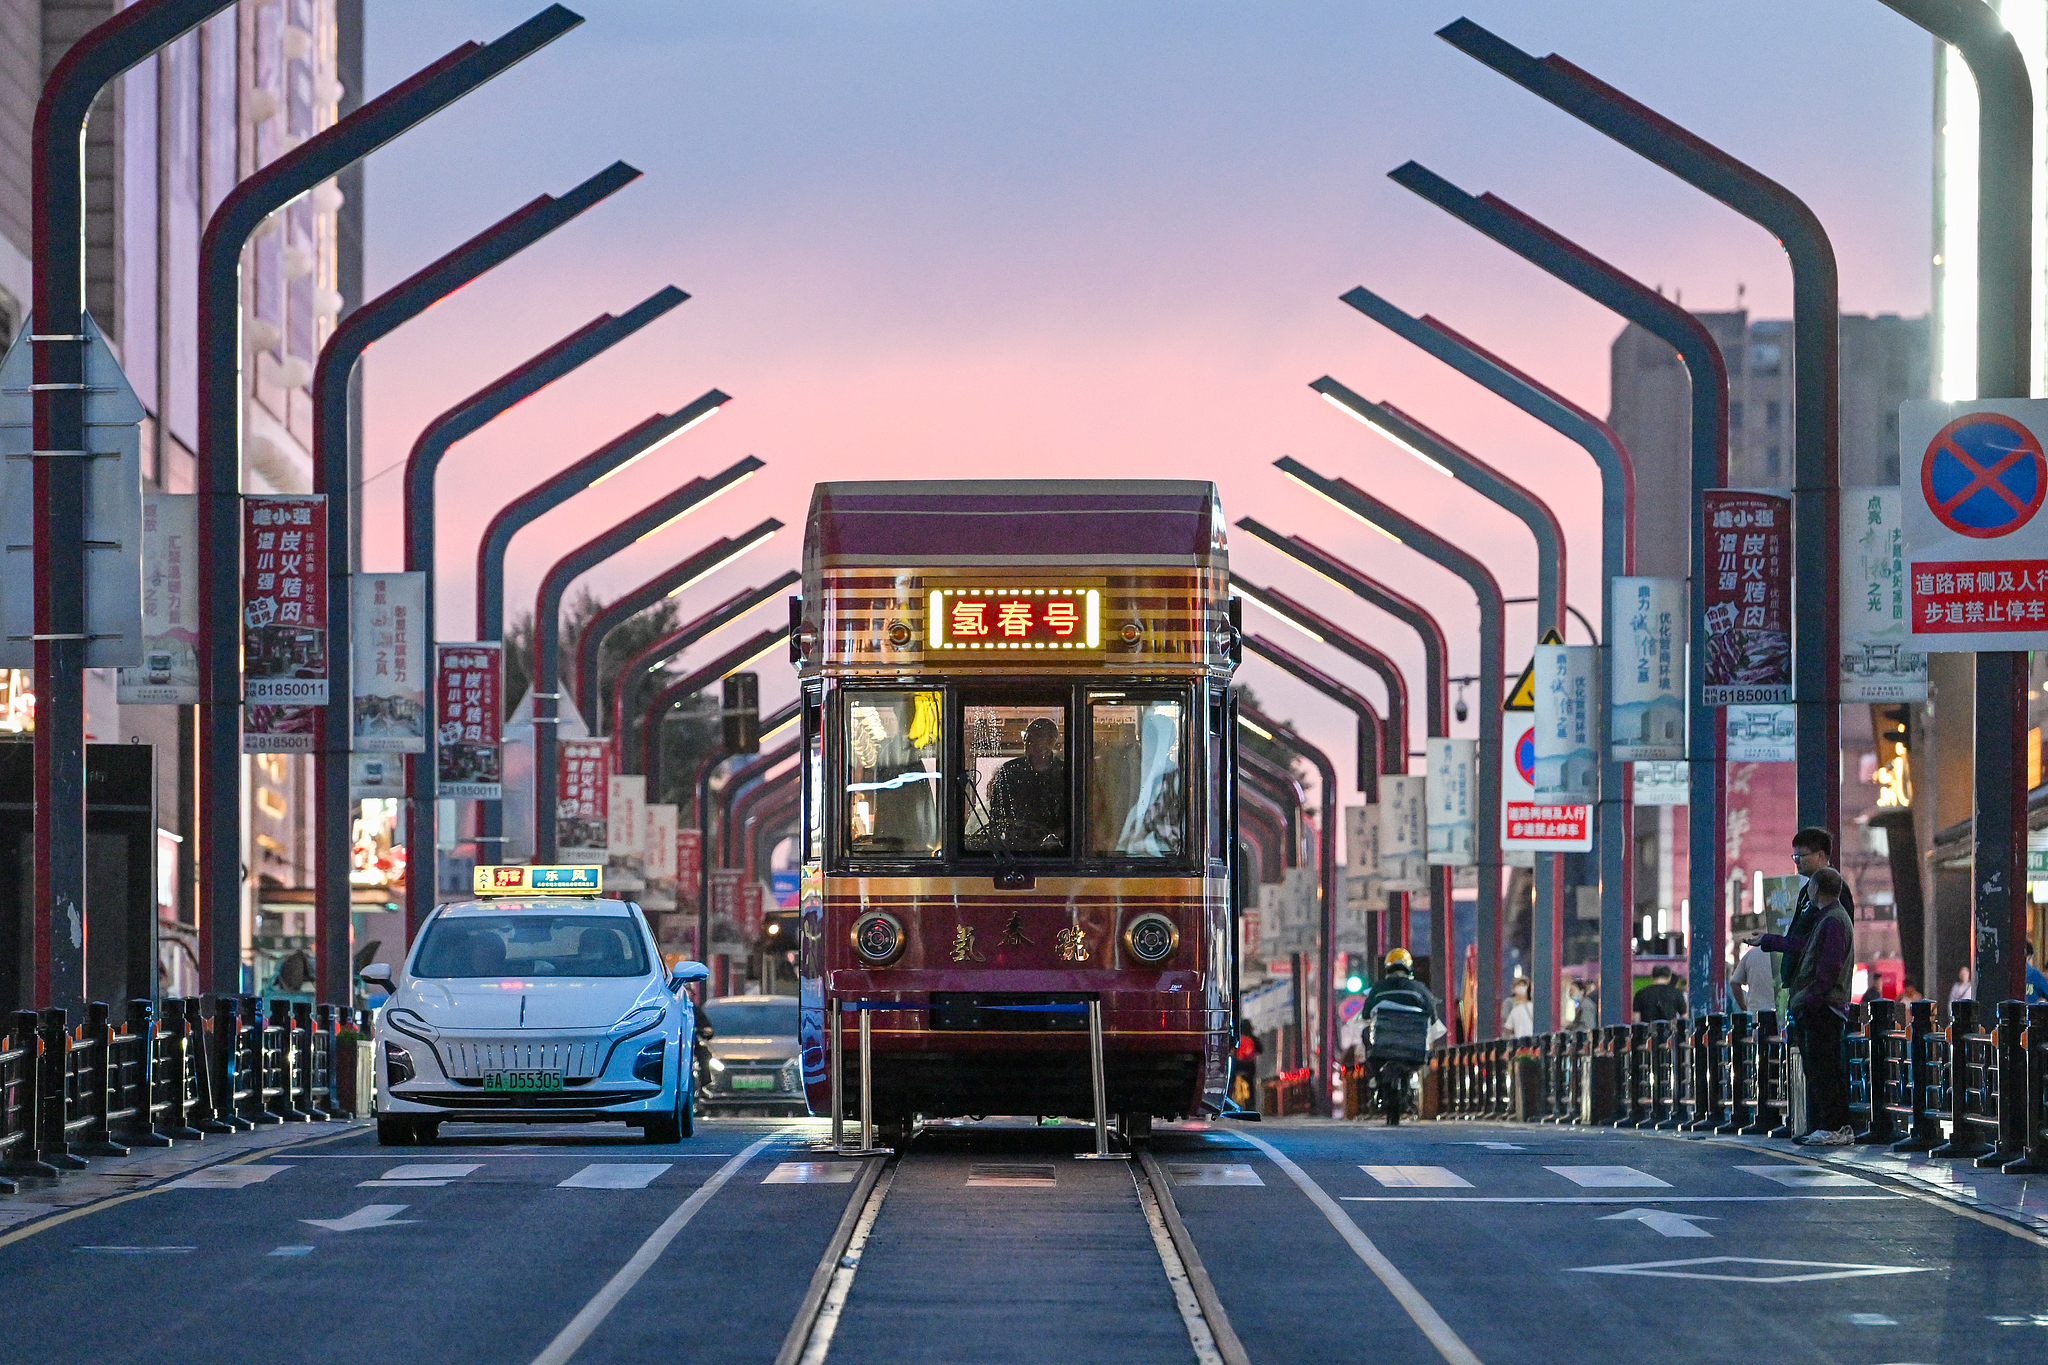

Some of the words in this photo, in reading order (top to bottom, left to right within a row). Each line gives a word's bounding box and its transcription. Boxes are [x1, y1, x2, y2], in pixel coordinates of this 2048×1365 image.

[279, 531, 302, 621] 炭火烤肉
[1741, 533, 1767, 628] 炭火烤肉
[1915, 570, 2048, 595] 道路两侧及人行
[951, 600, 1080, 638] 氢春号
[1924, 599, 2046, 624] 步道禁止停车
[258, 683, 324, 696] 81850011
[1719, 689, 1787, 702] 81850011
[497, 870, 521, 882] 有客
[486, 1073, 502, 1088] 吉A
[509, 1072, 560, 1089] D55305
